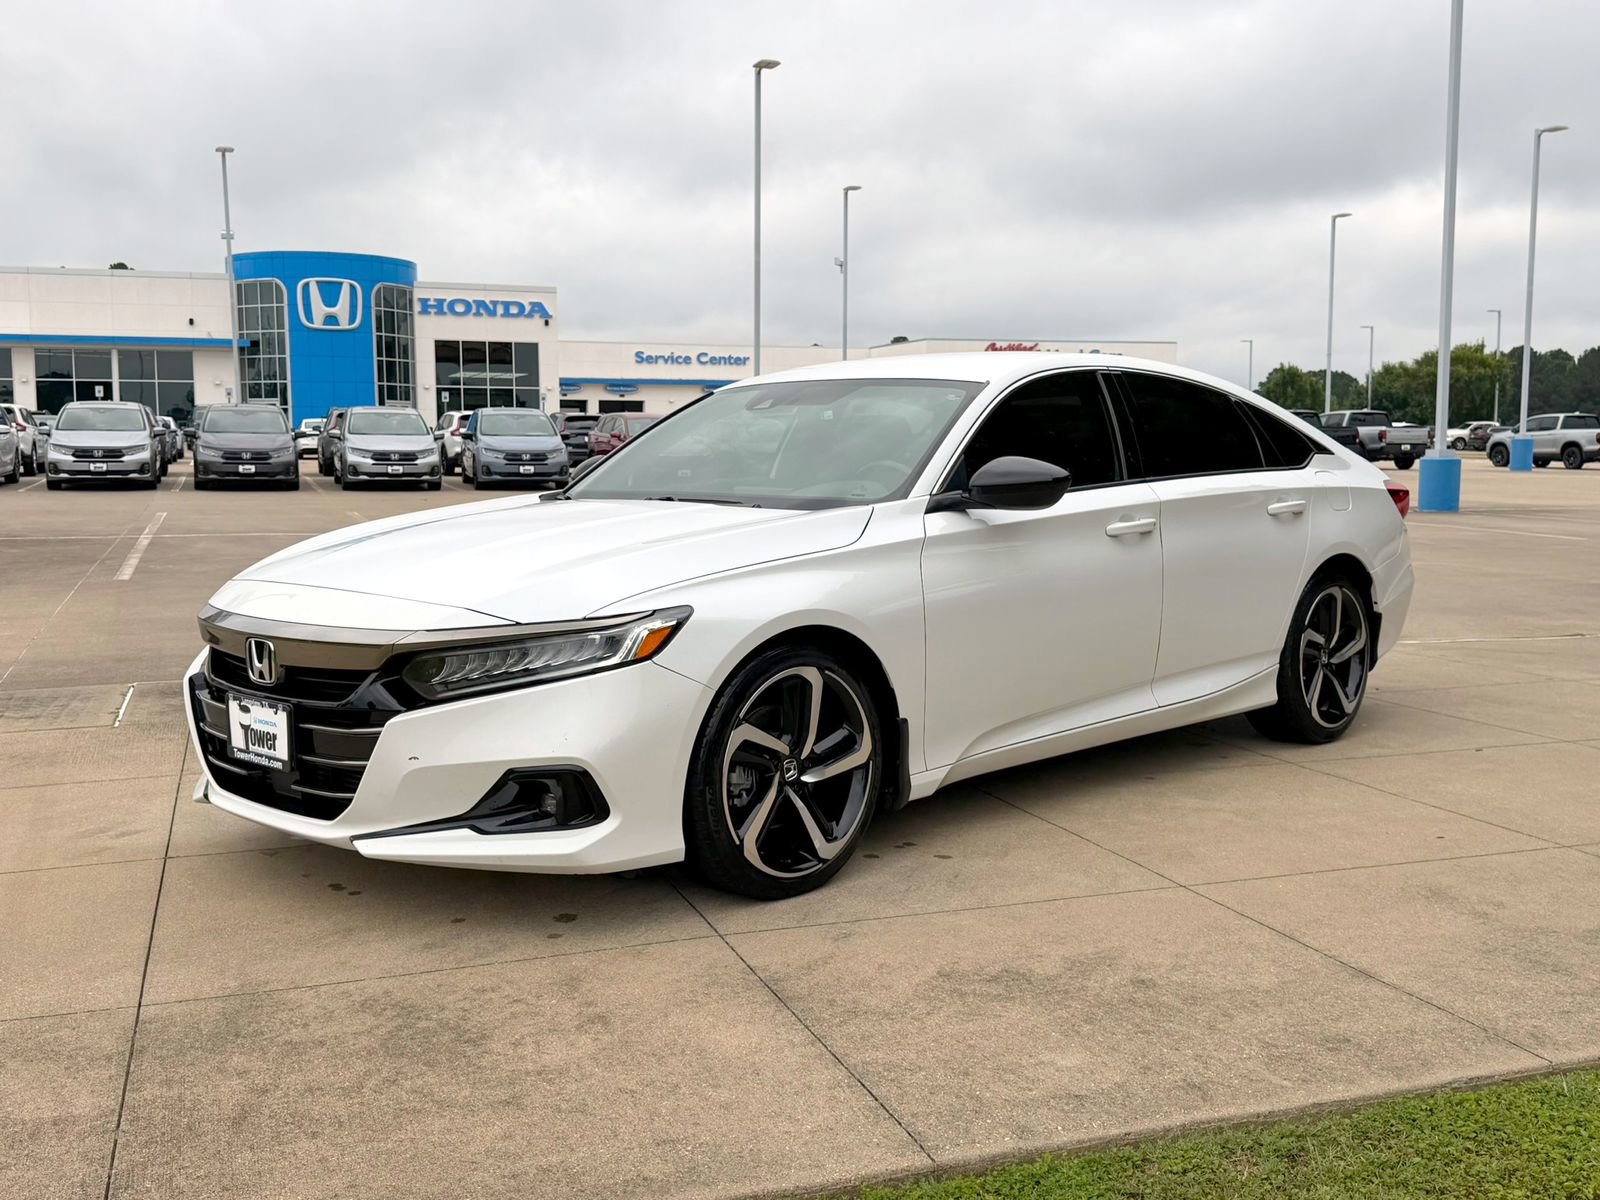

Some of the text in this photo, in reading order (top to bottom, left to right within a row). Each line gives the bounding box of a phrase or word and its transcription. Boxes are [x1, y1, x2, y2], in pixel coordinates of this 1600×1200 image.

[417, 297, 553, 319] HONDA
[634, 350, 751, 366] Service Center
[239, 721, 278, 752] Tower
[233, 748, 283, 770] TowerHonda.com
